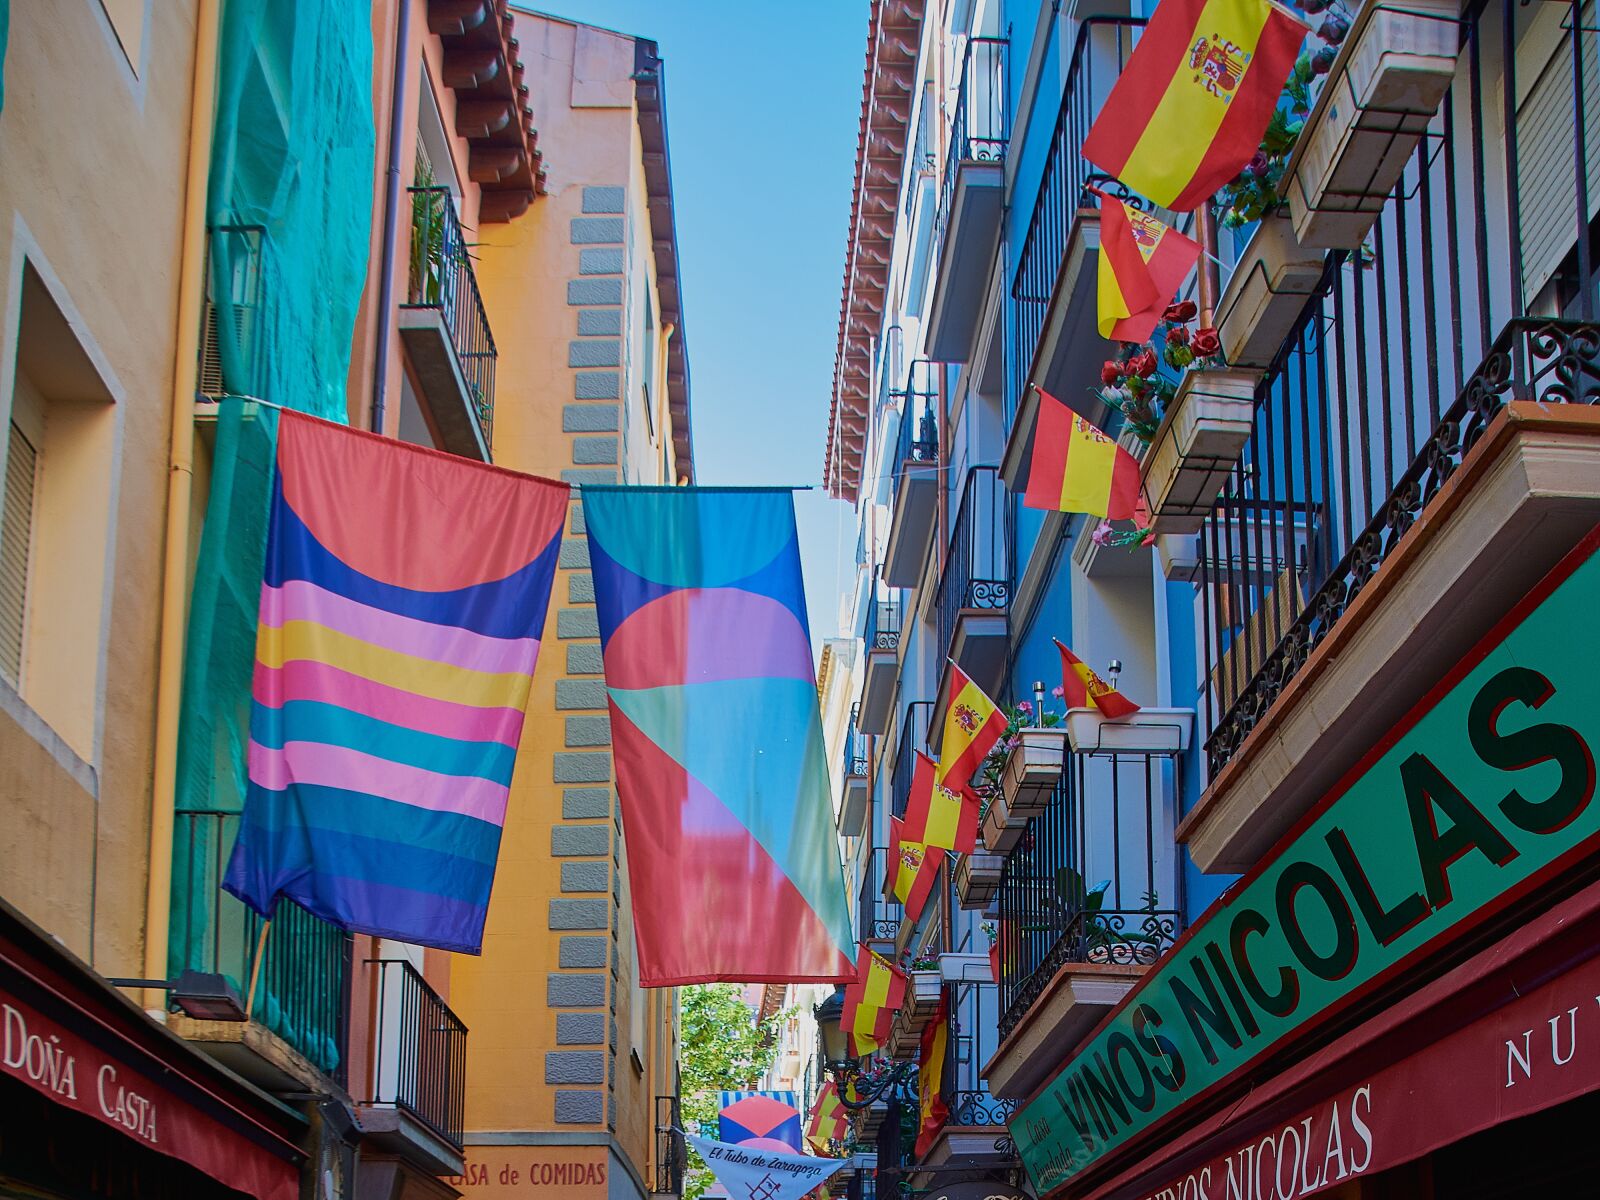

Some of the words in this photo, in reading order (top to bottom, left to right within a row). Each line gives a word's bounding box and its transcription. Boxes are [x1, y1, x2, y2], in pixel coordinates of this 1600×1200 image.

[1054, 1003, 1186, 1152] VINOS
[1168, 666, 1598, 1066] NICOLAS
[1505, 996, 1600, 1087] NU
[2, 1003, 78, 1100] DOÑA
[97, 1064, 159, 1143] CASTA
[1026, 1116, 1052, 1146] Casa
[499, 1164, 520, 1186] de
[530, 1163, 606, 1186] COMIDAS
[708, 1147, 721, 1160] El
[723, 1149, 748, 1165] Tubo
[751, 1154, 765, 1167] de
[767, 1157, 822, 1179] Zaragoza
[1033, 1142, 1074, 1188] Fundada
